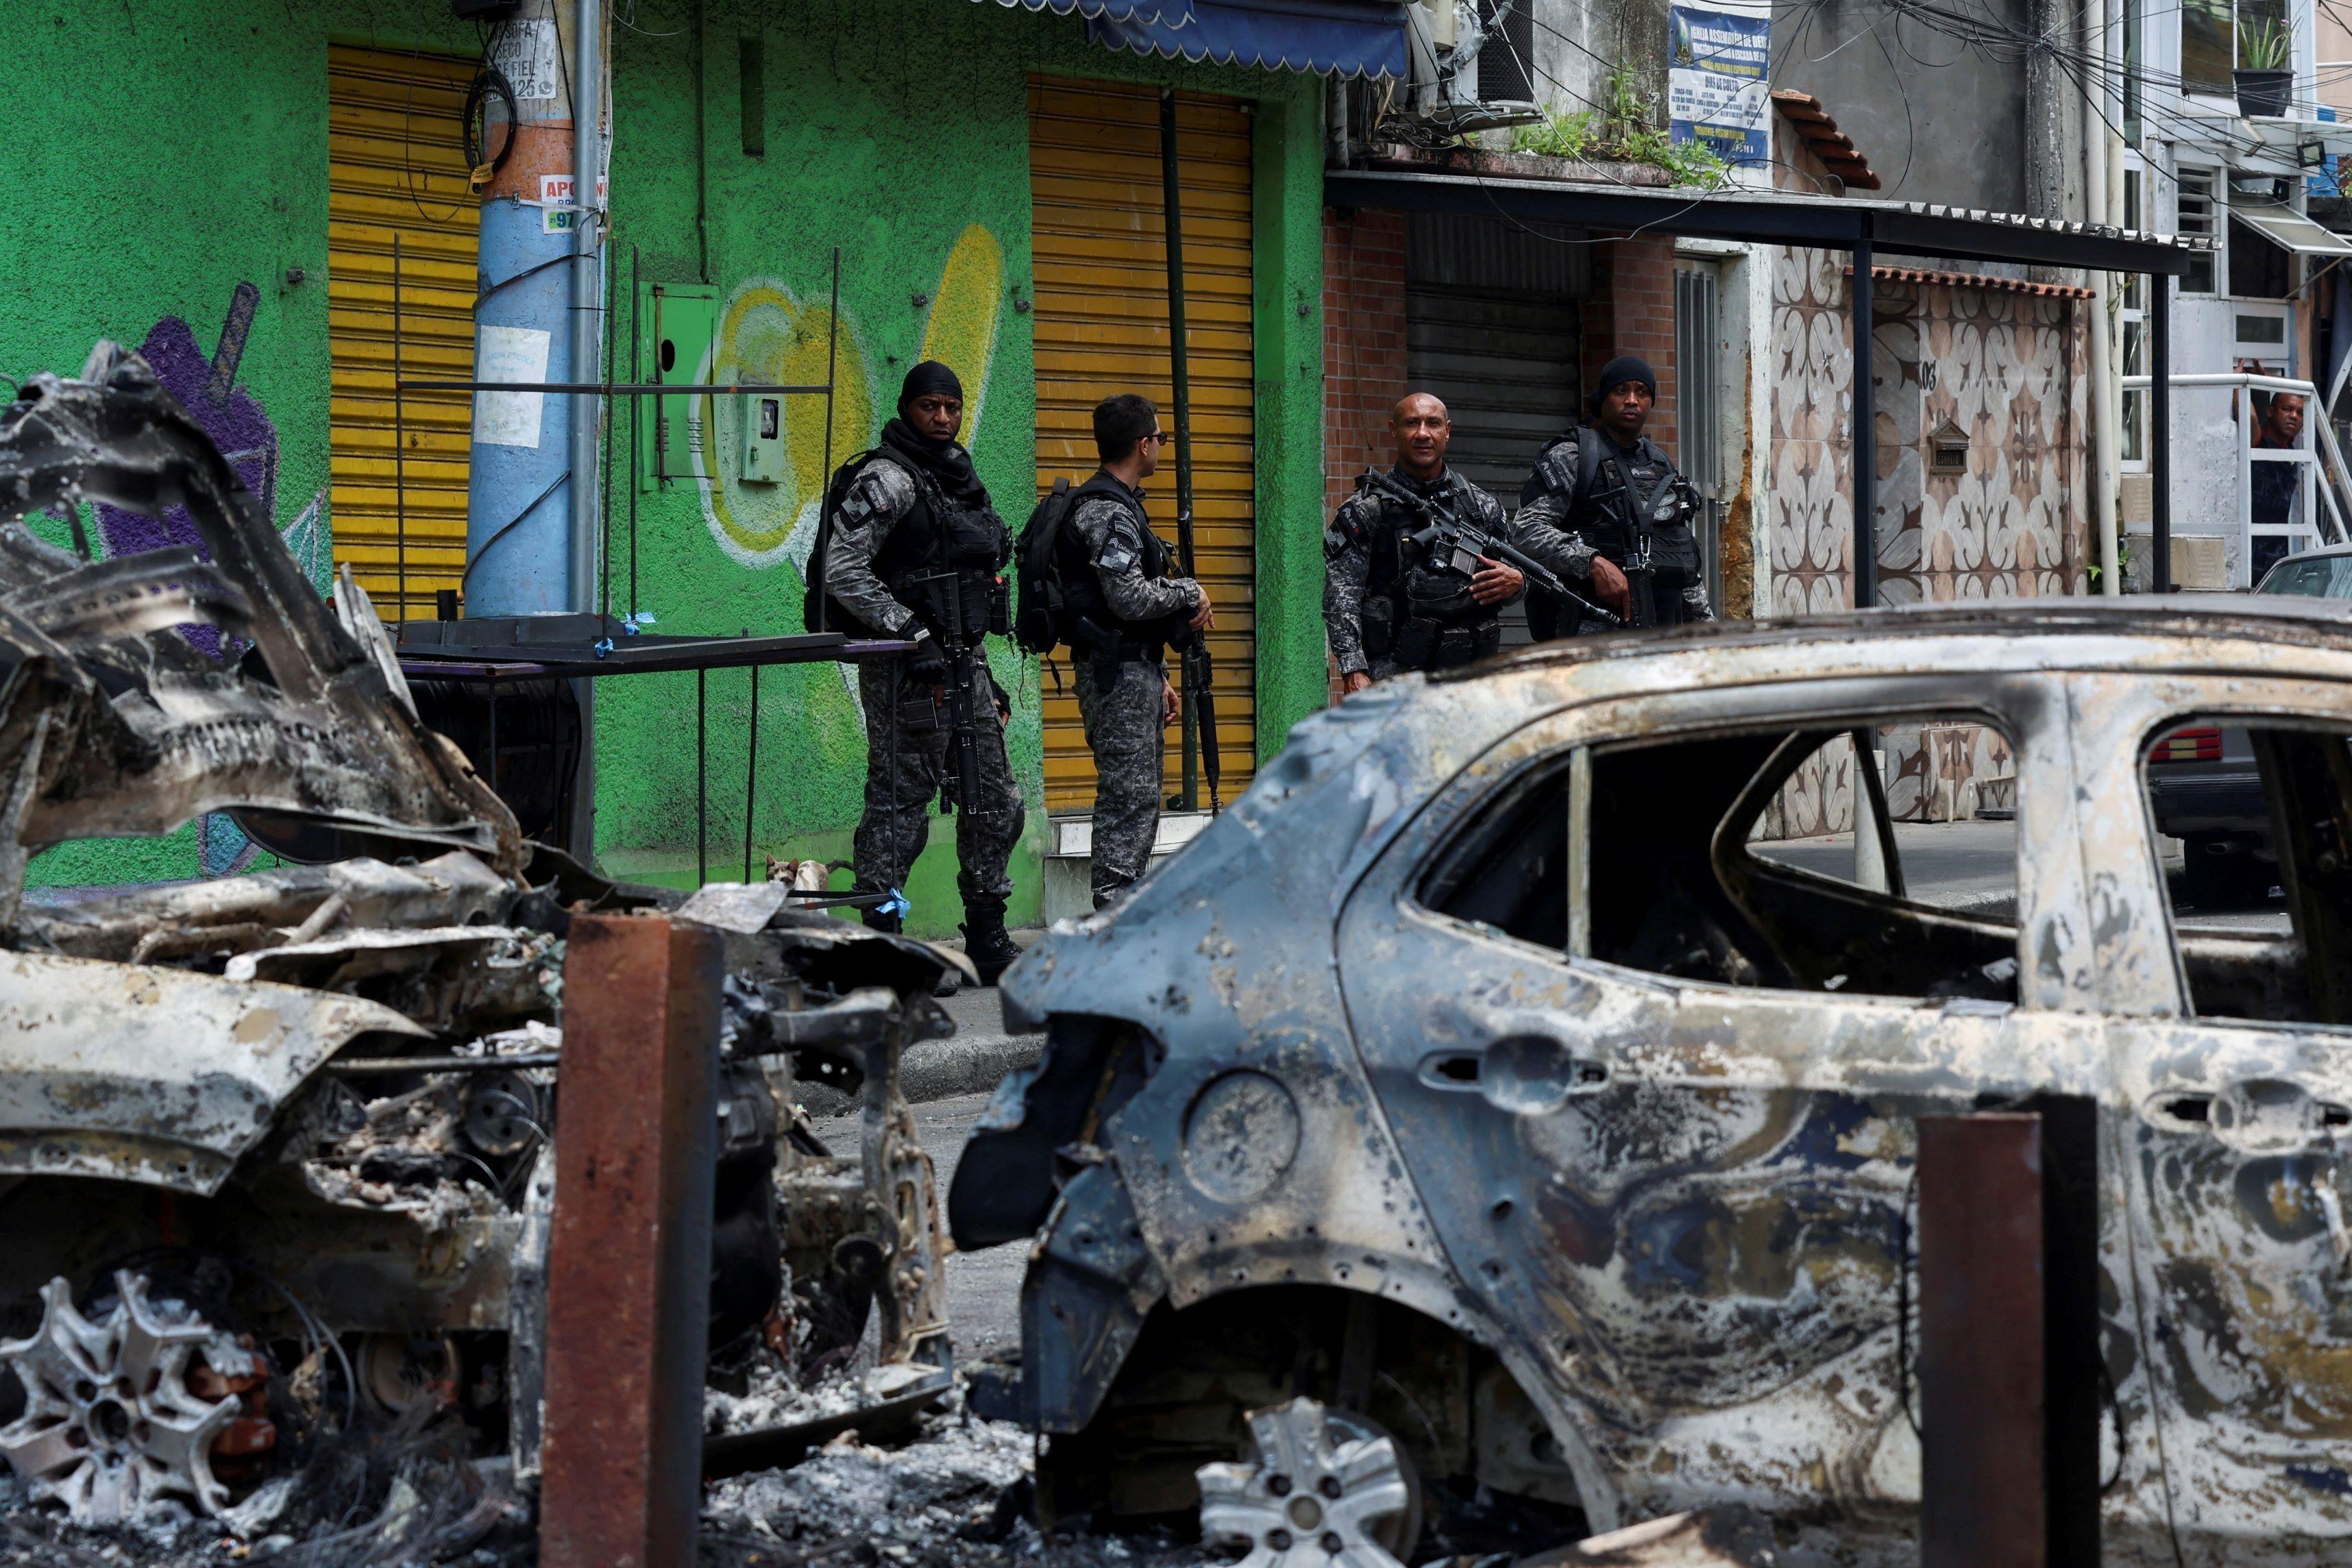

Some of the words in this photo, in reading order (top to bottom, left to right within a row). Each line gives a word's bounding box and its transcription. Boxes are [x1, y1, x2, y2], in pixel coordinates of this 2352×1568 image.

[1691, 26, 1708, 42] IGREJA
[1743, 34, 1752, 47] DE
[498, 42, 521, 59] SECO
[510, 60, 535, 77] FIEL
[1705, 75, 1715, 89] DIAS
[1716, 77, 1722, 90] DE
[1922, 360, 1937, 391] 03
[1547, 469, 1557, 485] MAYCON
[1118, 543, 1136, 557] CARVALHO
